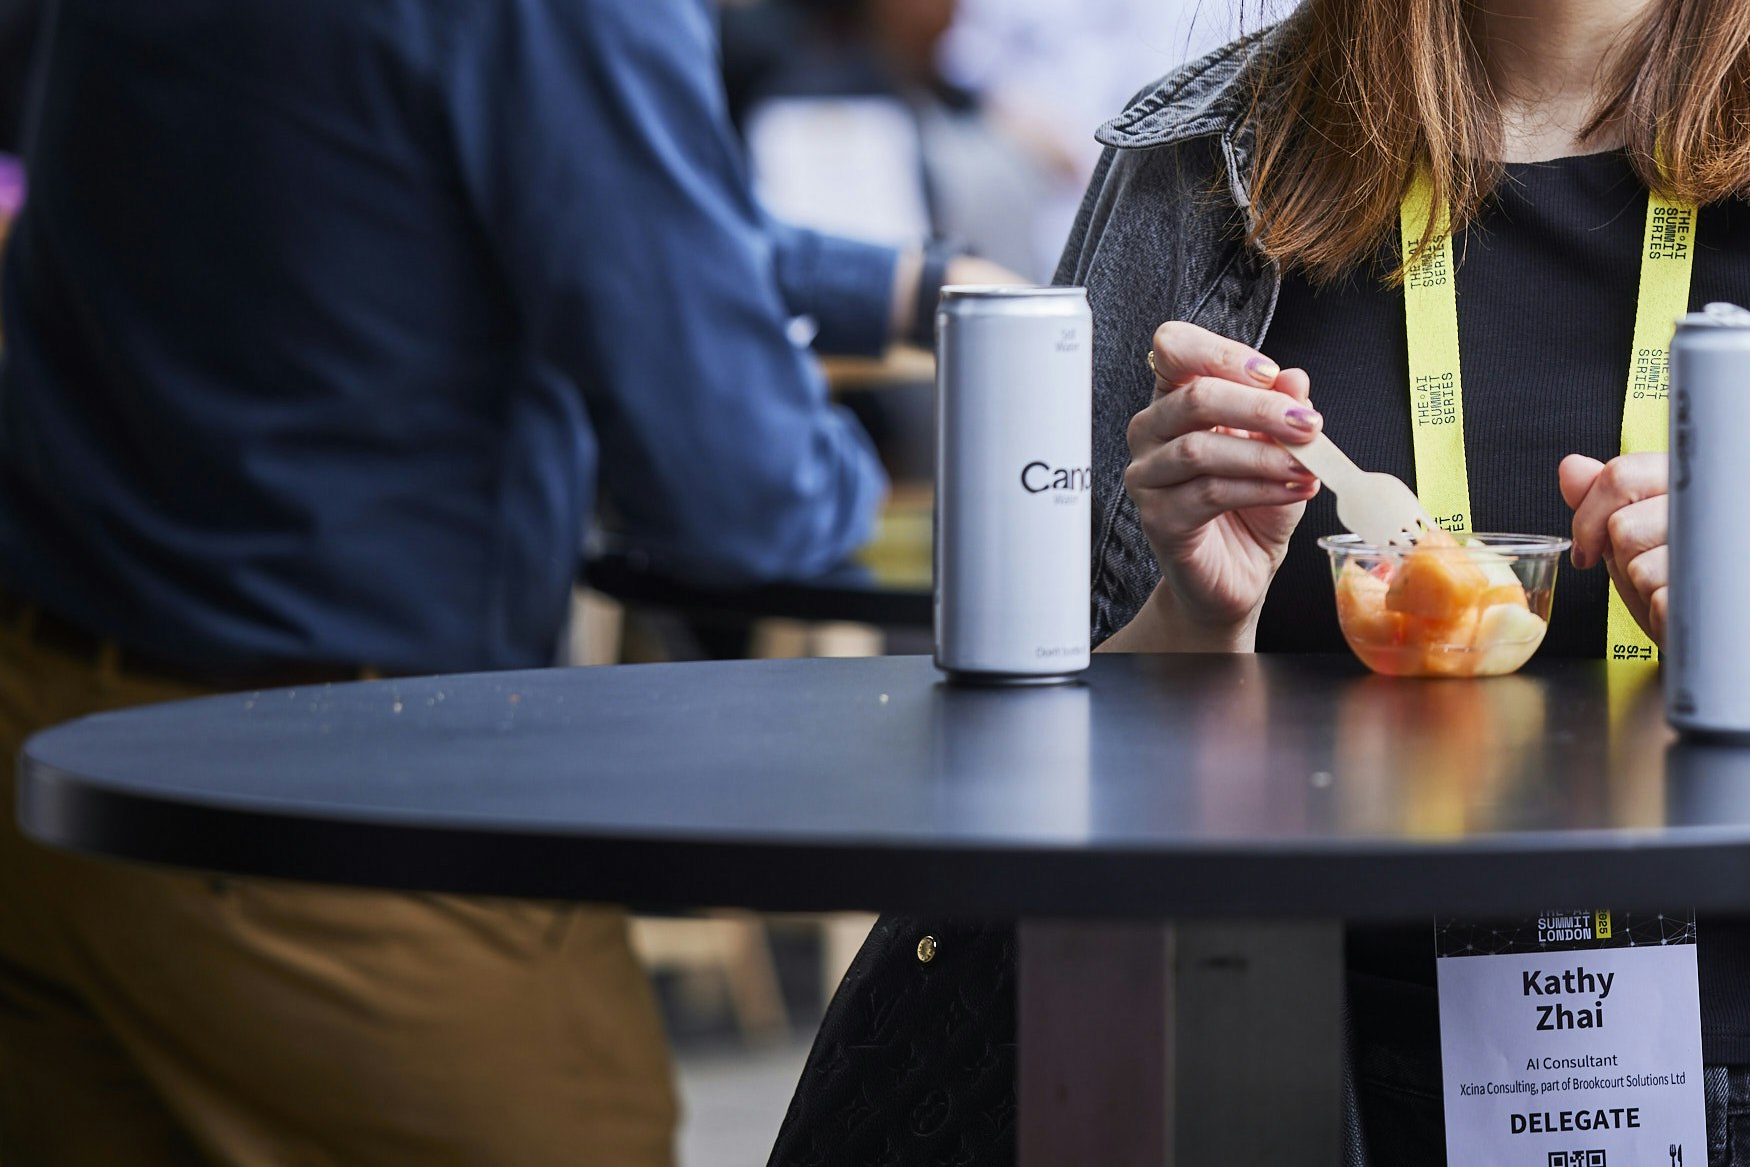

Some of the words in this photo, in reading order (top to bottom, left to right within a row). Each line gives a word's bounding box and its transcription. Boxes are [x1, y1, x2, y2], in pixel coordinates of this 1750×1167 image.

[1649, 207, 1665, 260] SERIES
[1662, 207, 1678, 260] SUMMIT
[1677, 208, 1691, 233] THE
[1674, 243, 1687, 260] AI
[1416, 375, 1428, 392] AI
[1633, 348, 1650, 399] SERIES
[1646, 349, 1663, 400] SUMMIT
[1429, 375, 1443, 425] SUMMIT
[1442, 372, 1456, 424] SERIES
[1417, 401, 1430, 426] THE
[1538, 915, 1591, 930] SUMMIT
[1538, 927, 1592, 943] LONDON
[1522, 966, 1615, 999] Kathy
[1536, 1001, 1604, 1031] Zhai
[1526, 1058, 1540, 1071] AI
[1543, 1054, 1619, 1070] Consultant
[1460, 1082, 1486, 1096] Xcina
[1487, 1079, 1539, 1096] Consulting,
[1541, 1081, 1560, 1093] part
[1561, 1077, 1572, 1091] of
[1573, 1075, 1625, 1091] Brookcourt
[1626, 1073, 1669, 1087] Solutions
[1670, 1071, 1686, 1085] Ltd
[1510, 1107, 1641, 1135] DELEGATE
